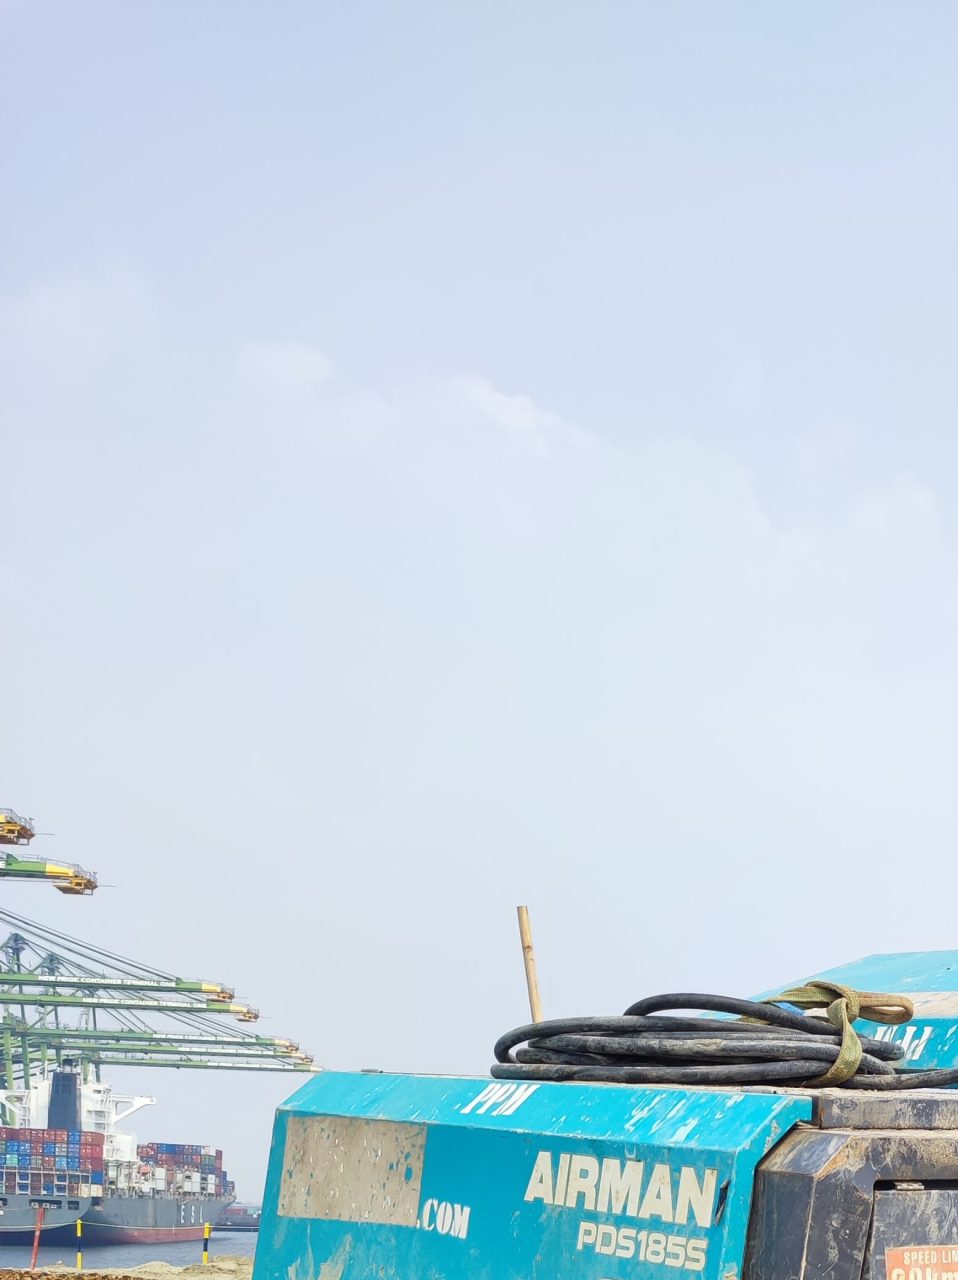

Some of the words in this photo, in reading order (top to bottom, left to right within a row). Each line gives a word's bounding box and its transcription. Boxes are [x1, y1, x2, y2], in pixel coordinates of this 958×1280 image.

[460, 1083, 541, 1116] PPM
[524, 1151, 718, 1228] AIRMAN
[577, 1221, 708, 1271] PDS185S
[903, 1251, 937, 1265] SPEED
